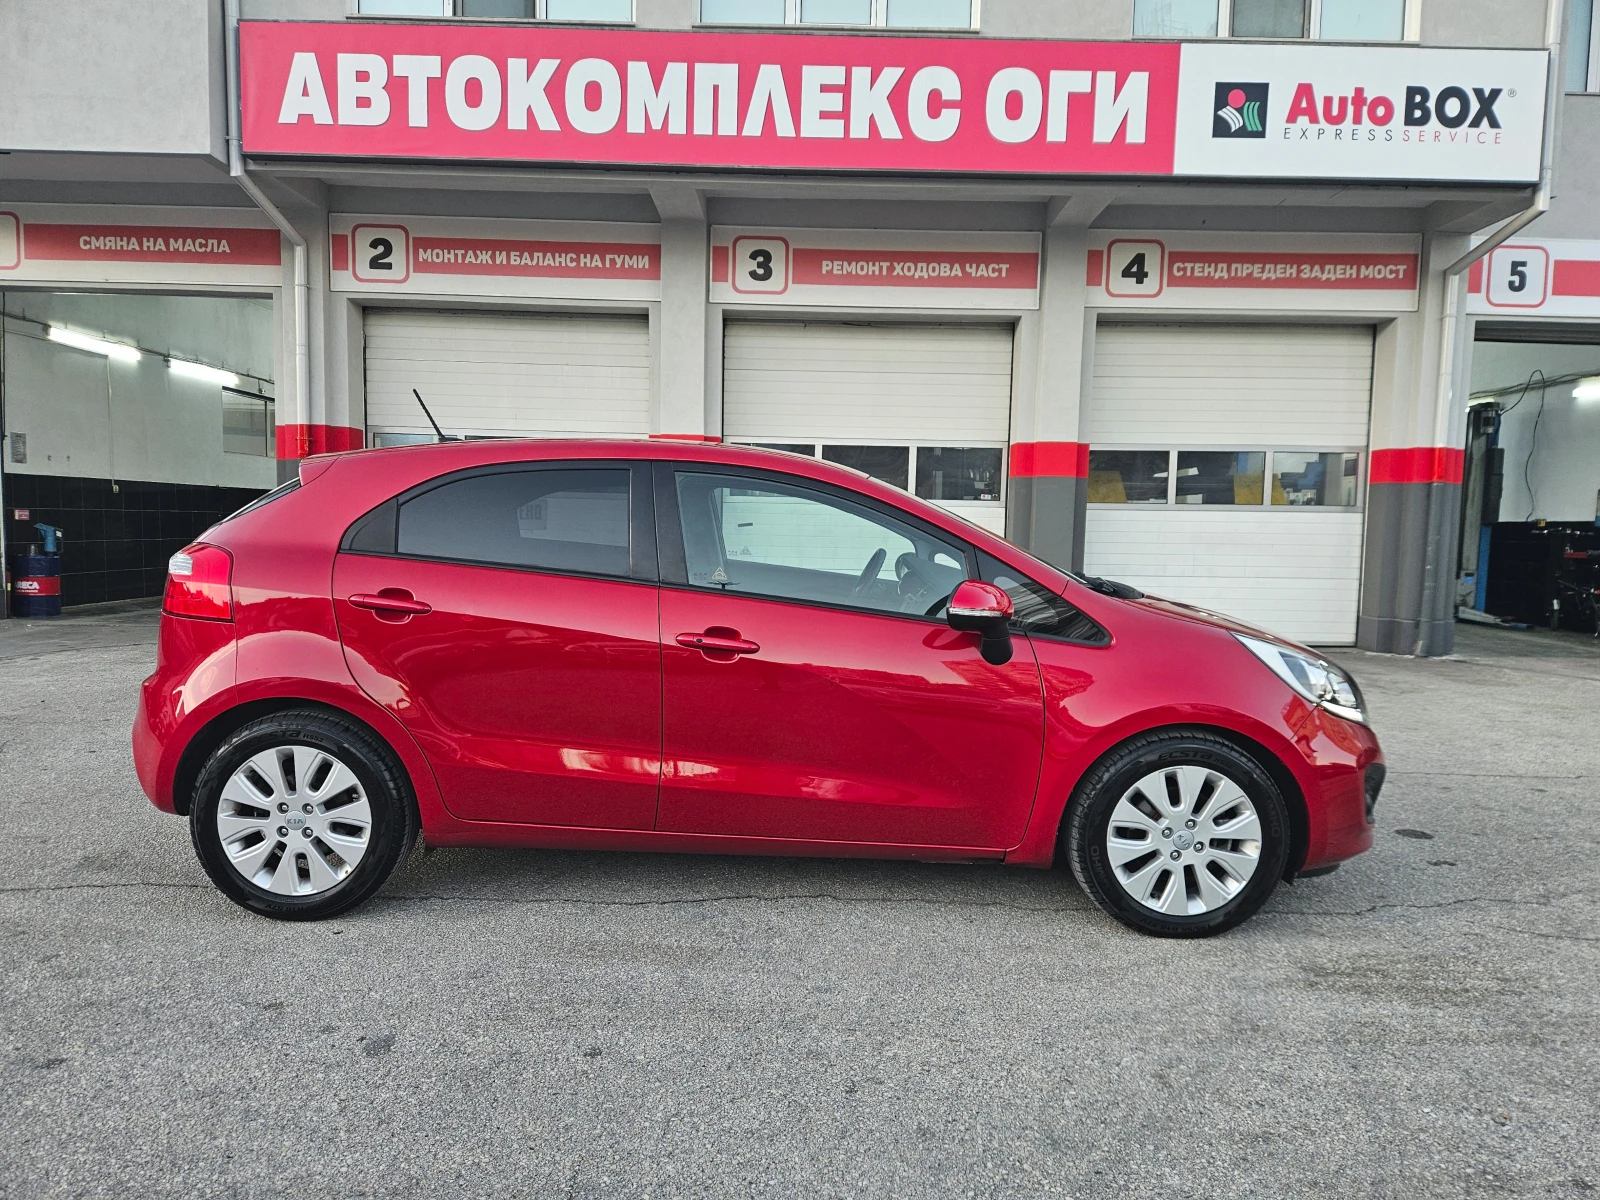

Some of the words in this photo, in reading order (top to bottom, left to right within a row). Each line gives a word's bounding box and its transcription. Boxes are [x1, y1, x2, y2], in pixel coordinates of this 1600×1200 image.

[278, 52, 962, 142] АВТОКОМПЛЕКС
[986, 67, 1150, 144] ОГИ
[1285, 83, 1395, 126] Auto
[1403, 85, 1503, 129] BOX
[1283, 127, 1393, 142] EXPRESS
[1402, 130, 1502, 144] SERVICE
[79, 235, 140, 251] СМЯНА
[143, 237, 166, 252] НА
[169, 238, 231, 253] МАСЛА
[368, 237, 394, 271] 2
[418, 248, 493, 265] МОНТАЖ
[495, 251, 507, 265] И
[510, 251, 577, 268] БАЛАНС
[579, 253, 603, 268] НА
[605, 254, 649, 269] ГУМИ
[748, 249, 773, 281] 3
[822, 260, 890, 276] РЕМОНТ
[892, 261, 962, 279] ХОДОВА
[965, 262, 1010, 278] ЧАСТ
[1121, 252, 1149, 285] 4
[1172, 262, 1229, 280] СТЕНД
[1231, 263, 1297, 281] ПРЕДЕН
[1300, 264, 1358, 282] ЗАДЕН
[1360, 264, 1407, 280] МОСТ
[1508, 260, 1527, 292] 5
